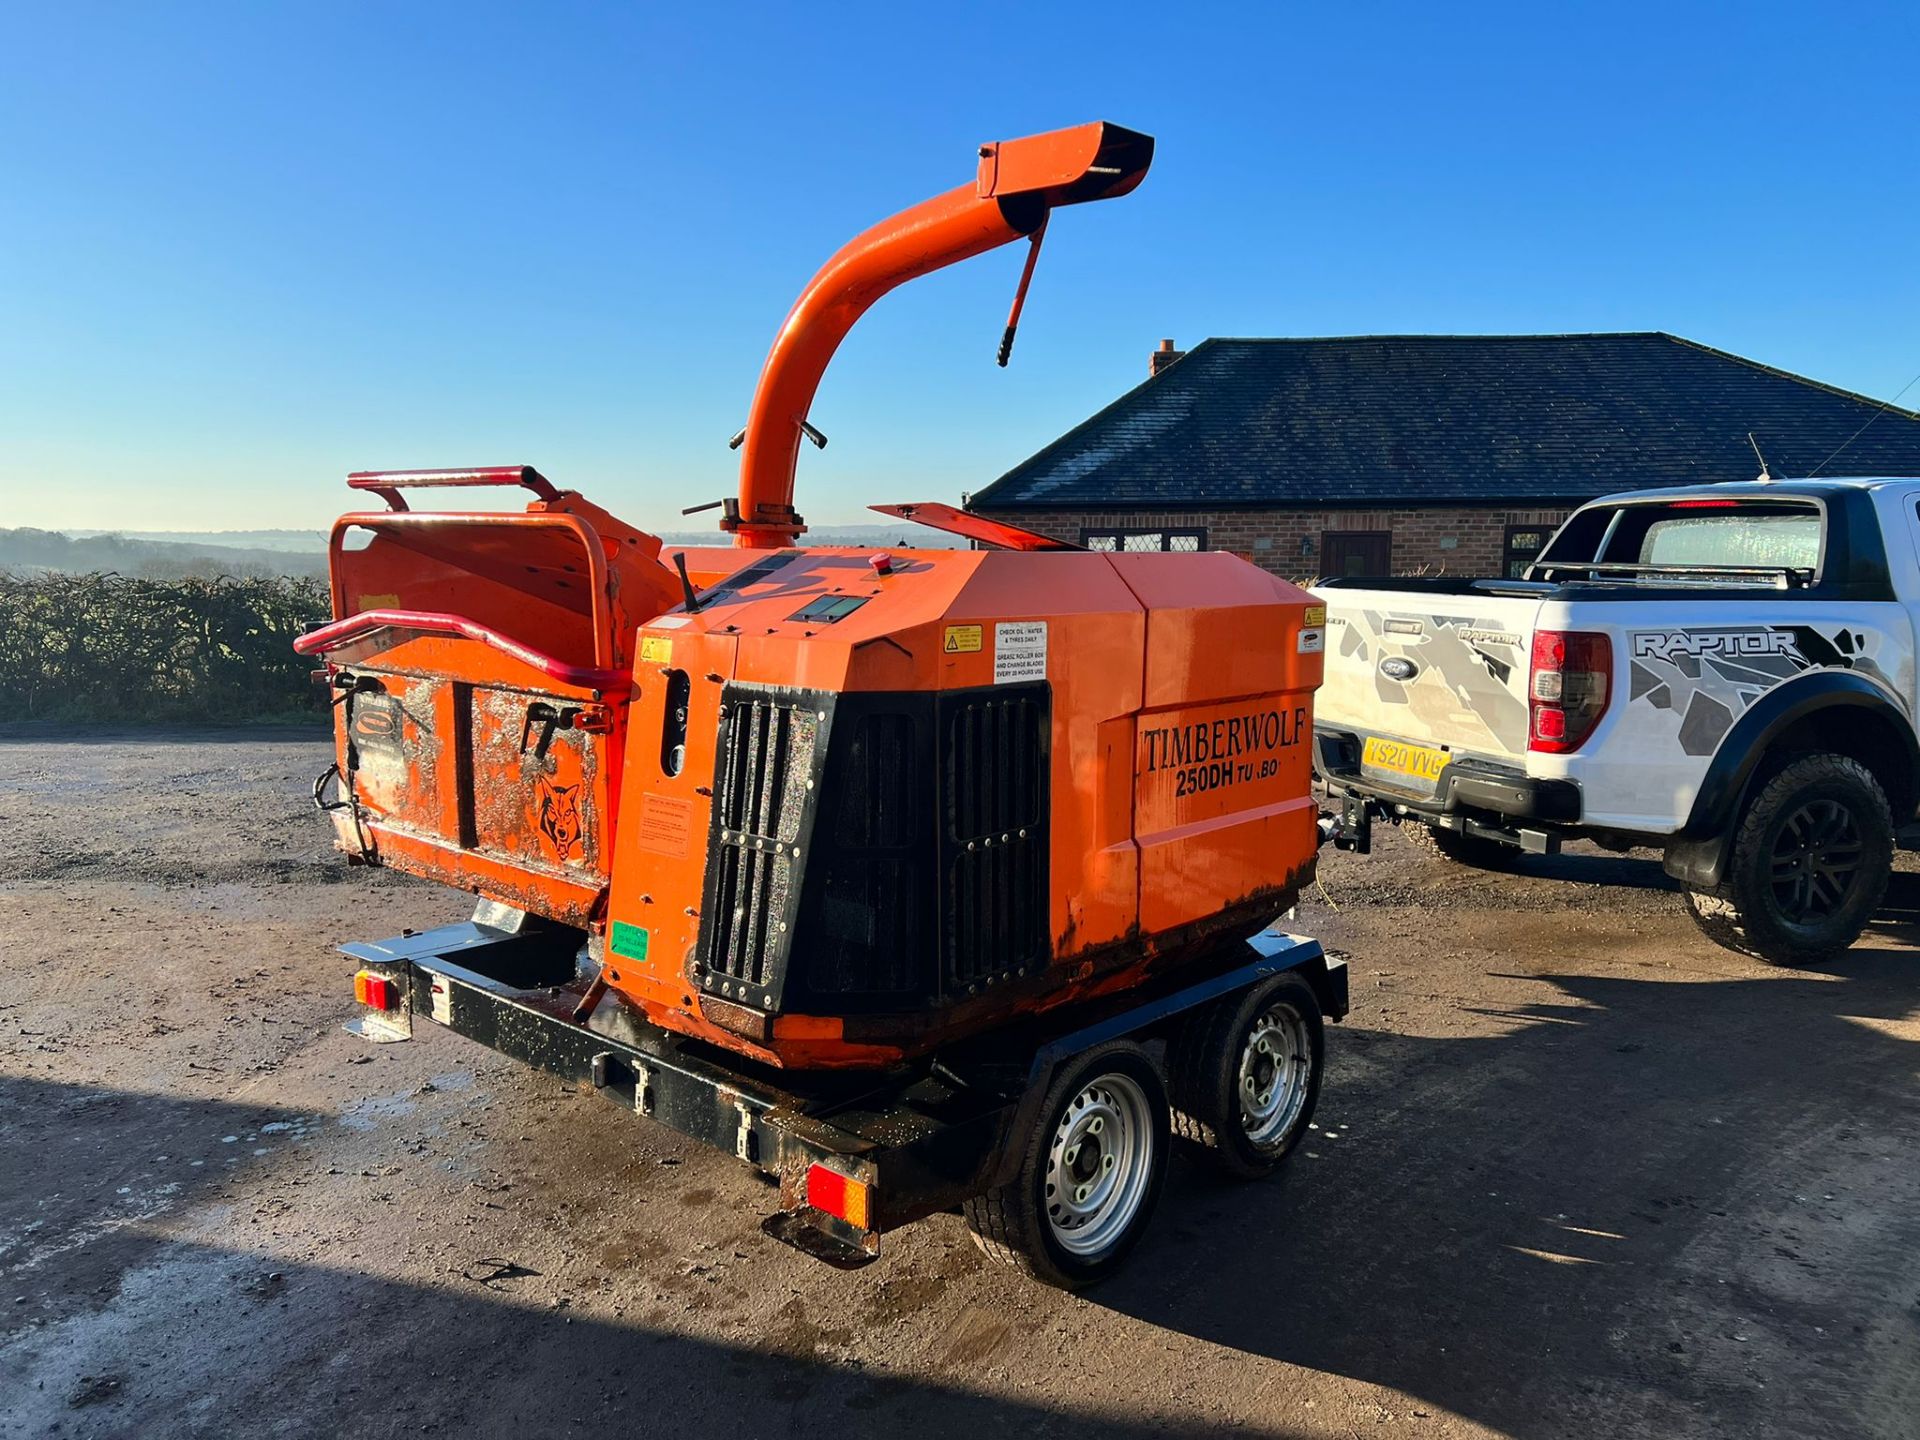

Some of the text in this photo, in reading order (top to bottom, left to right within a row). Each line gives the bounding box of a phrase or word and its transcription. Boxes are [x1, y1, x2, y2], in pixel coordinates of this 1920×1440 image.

[999, 628, 1016, 636] CHECK
[1460, 629, 1525, 651] RAPTOR
[1016, 652, 1033, 660] ROLLER
[1634, 632, 1811, 667] RAPTOR
[1144, 707, 1306, 772] TIMBERWOLF
[1370, 741, 1443, 775] YS20 VVG
[1175, 758, 1278, 798] 250DH TUBO
